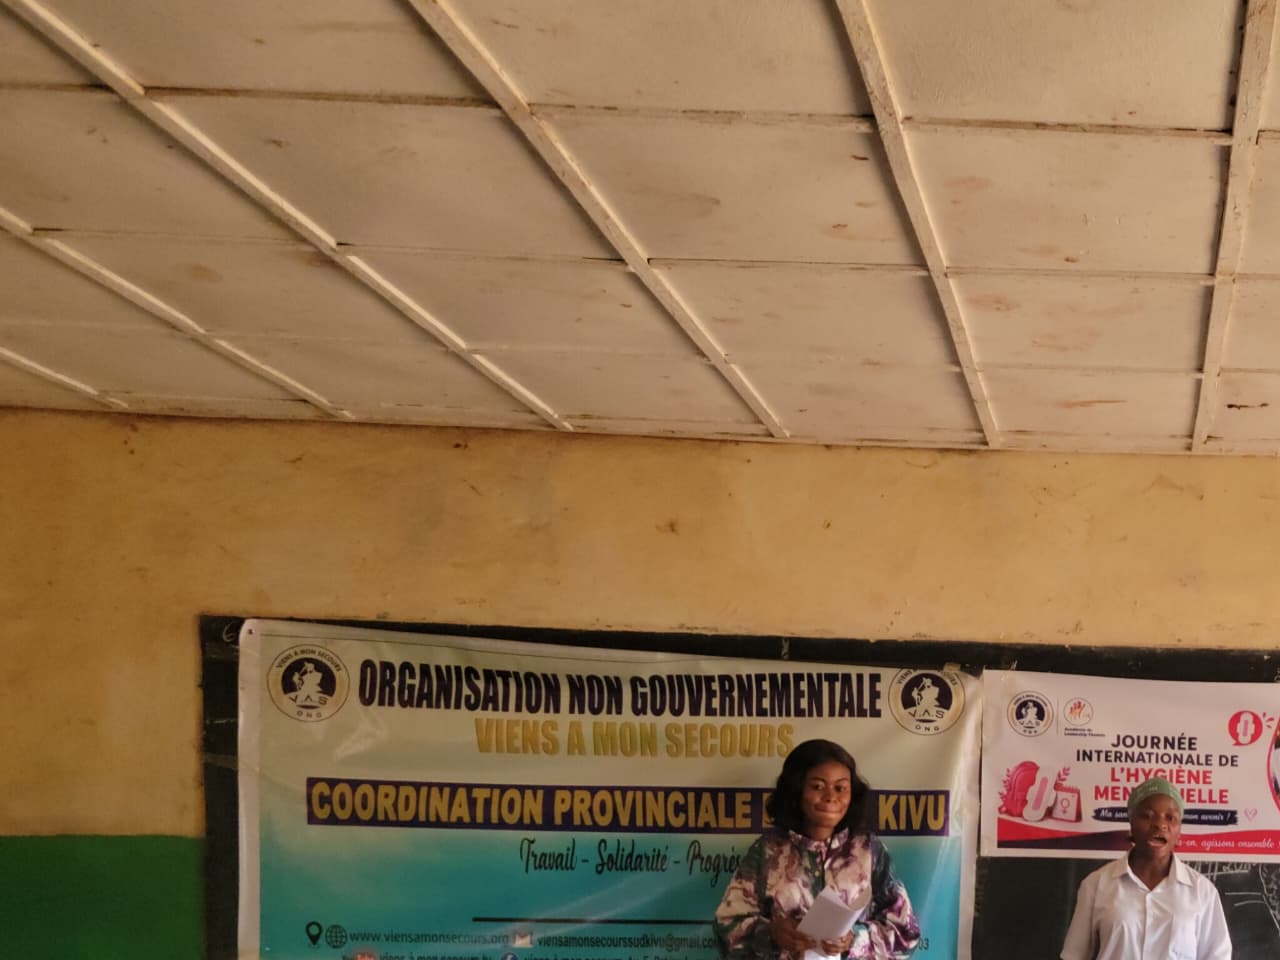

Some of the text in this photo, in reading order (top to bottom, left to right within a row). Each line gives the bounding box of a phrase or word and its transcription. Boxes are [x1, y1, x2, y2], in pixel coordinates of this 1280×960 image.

[358, 658, 882, 718] ORGANISATION NON GOUVERNEMENTALE
[474, 716, 795, 760] VIENS A MON SECOURS
[1110, 733, 1198, 751] JOURNÉE
[1076, 749, 1239, 767] INTERNATIONALE DE
[1110, 766, 1213, 785] L'HYGIÈNE
[311, 780, 544, 825] COORDINATION
[554, 788, 752, 828] PROVINCIALE
[878, 793, 946, 832] KIVU
[519, 837, 577, 874] Travail
[595, 838, 668, 875] Solidarité
